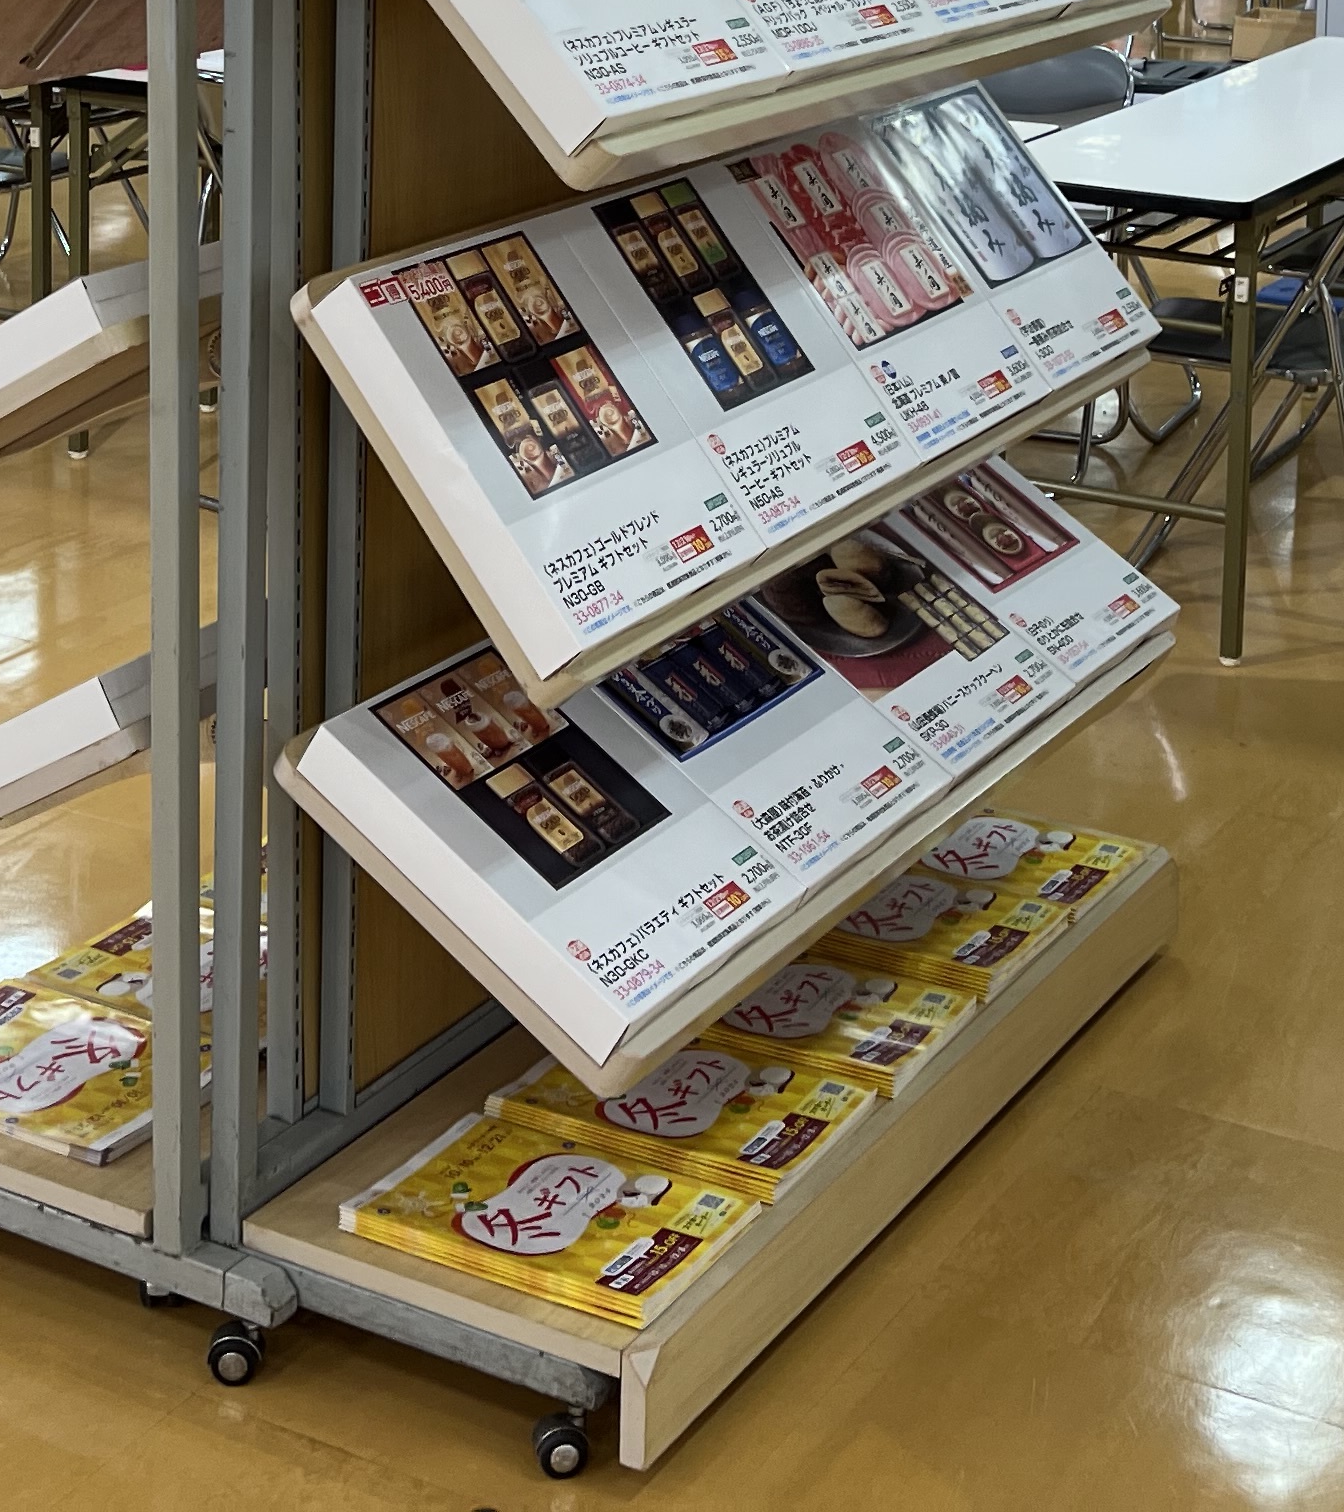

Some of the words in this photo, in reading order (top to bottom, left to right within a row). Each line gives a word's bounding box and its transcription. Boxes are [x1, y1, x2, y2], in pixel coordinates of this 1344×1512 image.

[583, 63, 627, 81] N30-AS
[730, 440, 802, 484] レギュラーソリュブル
[740, 476, 770, 497] コーヒー
[769, 453, 812, 482] ギフトセット
[748, 485, 785, 511] N50-AS
[552, 561, 599, 594] プレミアム
[598, 536, 649, 571] ギフトセット
[562, 579, 606, 609] N30-GB
[572, 589, 625, 626] 33-0877-34
[677, 871, 725, 909] ギフトセット
[599, 948, 650, 988] N30-GKC
[612, 959, 666, 1001] 33-0879-34
[476, 1165, 599, 1247] 冬ギフト
